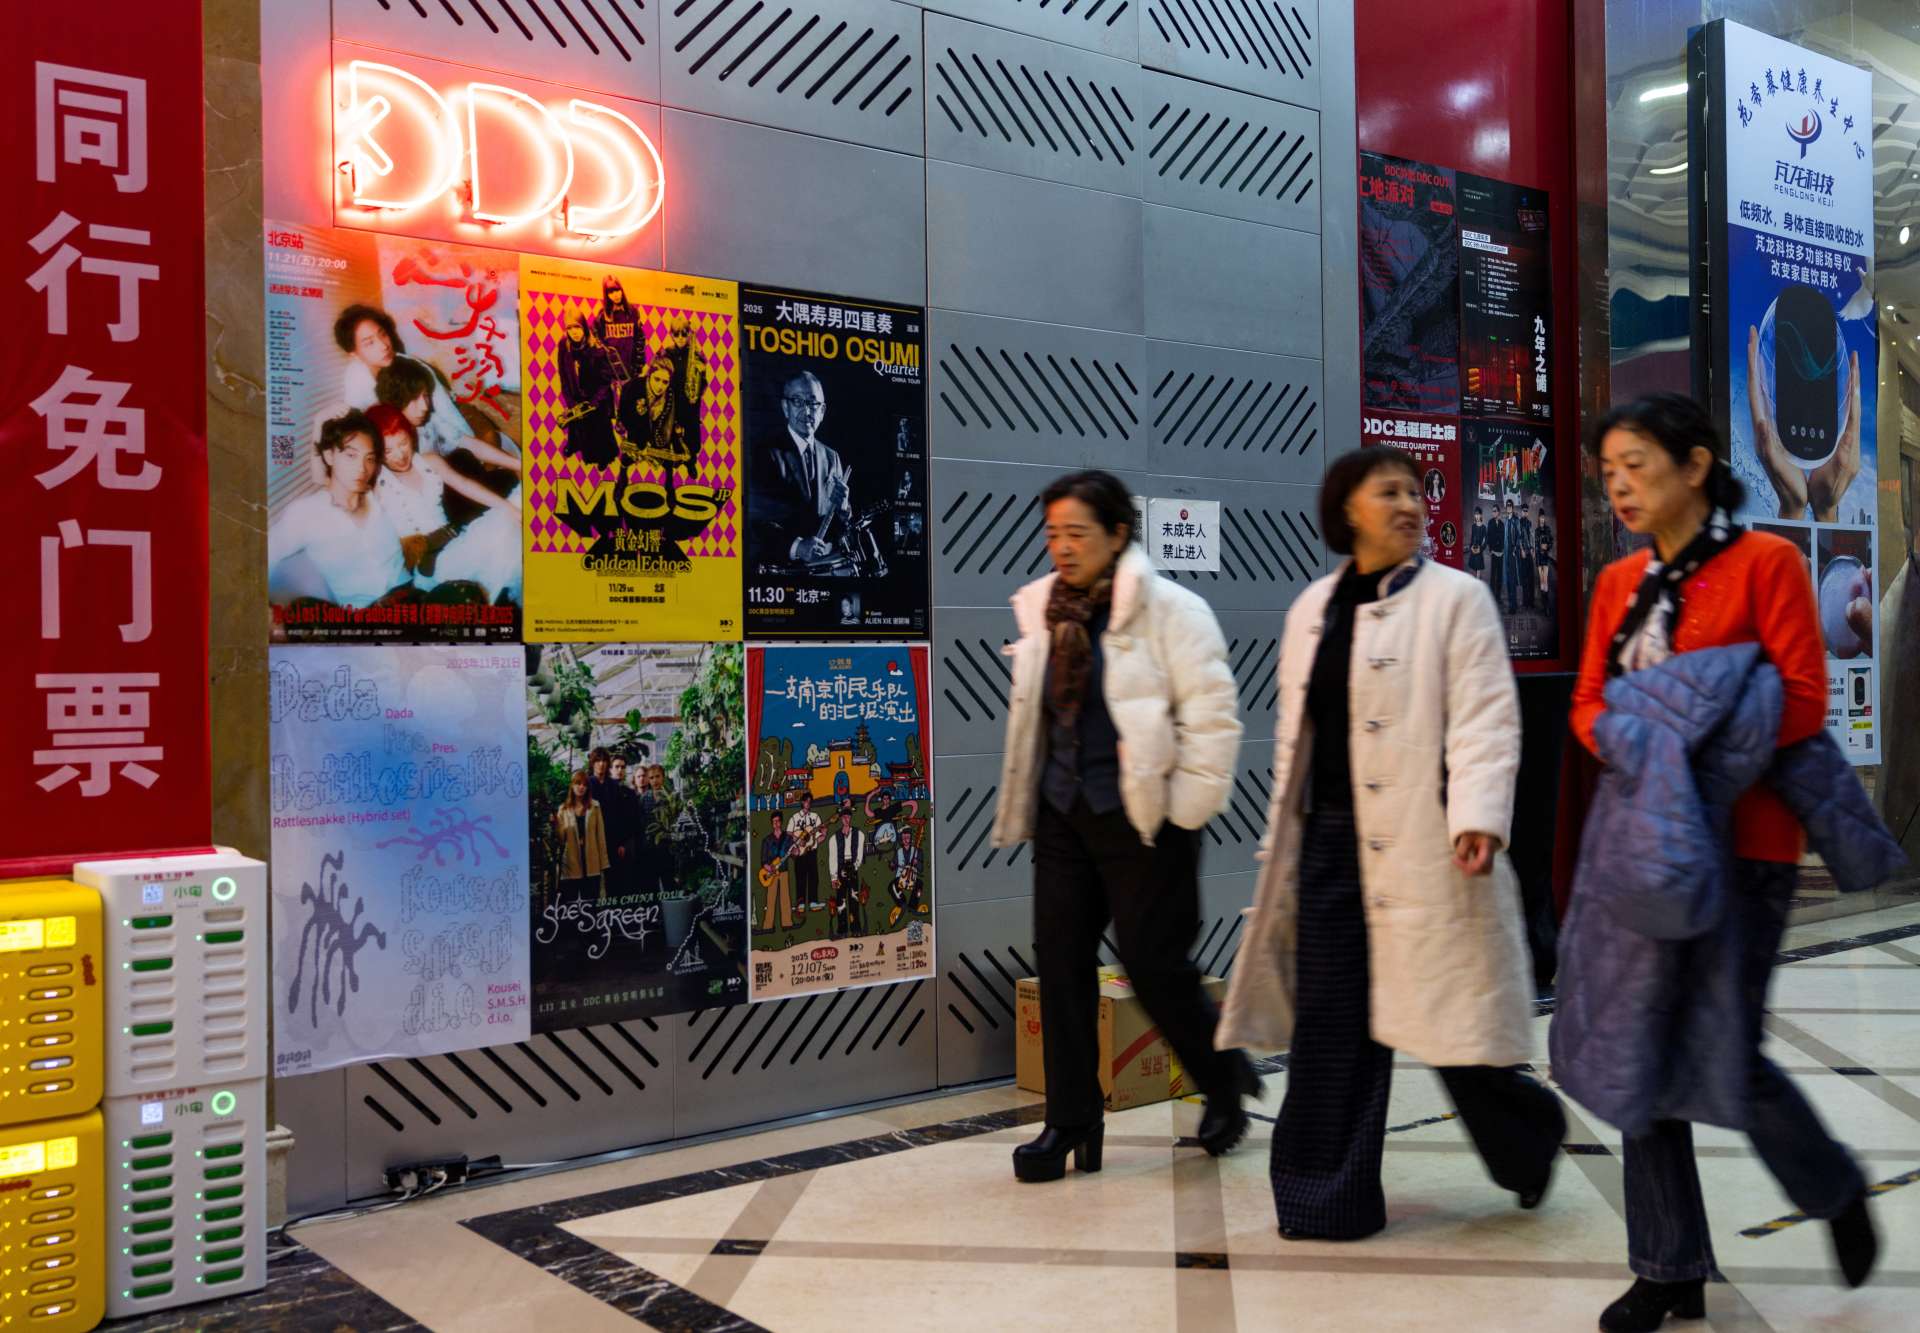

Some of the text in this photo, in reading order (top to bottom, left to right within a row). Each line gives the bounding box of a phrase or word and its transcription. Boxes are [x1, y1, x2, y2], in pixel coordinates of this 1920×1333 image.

[1774, 183, 1834, 208] PENGLONG KEJI
[267, 230, 305, 251] 北京站
[318, 258, 347, 269] 20:00
[1770, 260, 1839, 289] 改变家庭饮用水
[743, 304, 764, 314] 2025
[775, 300, 893, 335] 大隅寿男四重奏
[743, 324, 919, 368] TOSHIO OSUMI
[873, 359, 920, 377] Quartet
[26, 59, 164, 797] 同行免门票
[1408, 441, 1440, 451] QUARTET
[554, 478, 733, 522] MOS JP
[1162, 521, 1207, 539] 未成年人
[1162, 543, 1207, 560] 禁止进入
[581, 554, 638, 572] Golden
[640, 555, 694, 574] Echoes
[748, 586, 785, 603] 11.30
[796, 588, 820, 604] 北京
[446, 656, 521, 669] 2025年11月21日
[765, 673, 908, 712] 一支南京市民乐队
[384, 708, 414, 719] Dada
[273, 808, 411, 829] Rattlesnakke (Hybrid set)
[790, 952, 809, 962] 2025
[790, 960, 822, 977] 12/07
[487, 981, 522, 994] Kousei
[487, 996, 527, 1010] S.M.S.H
[487, 1012, 513, 1025] d.i.o.
